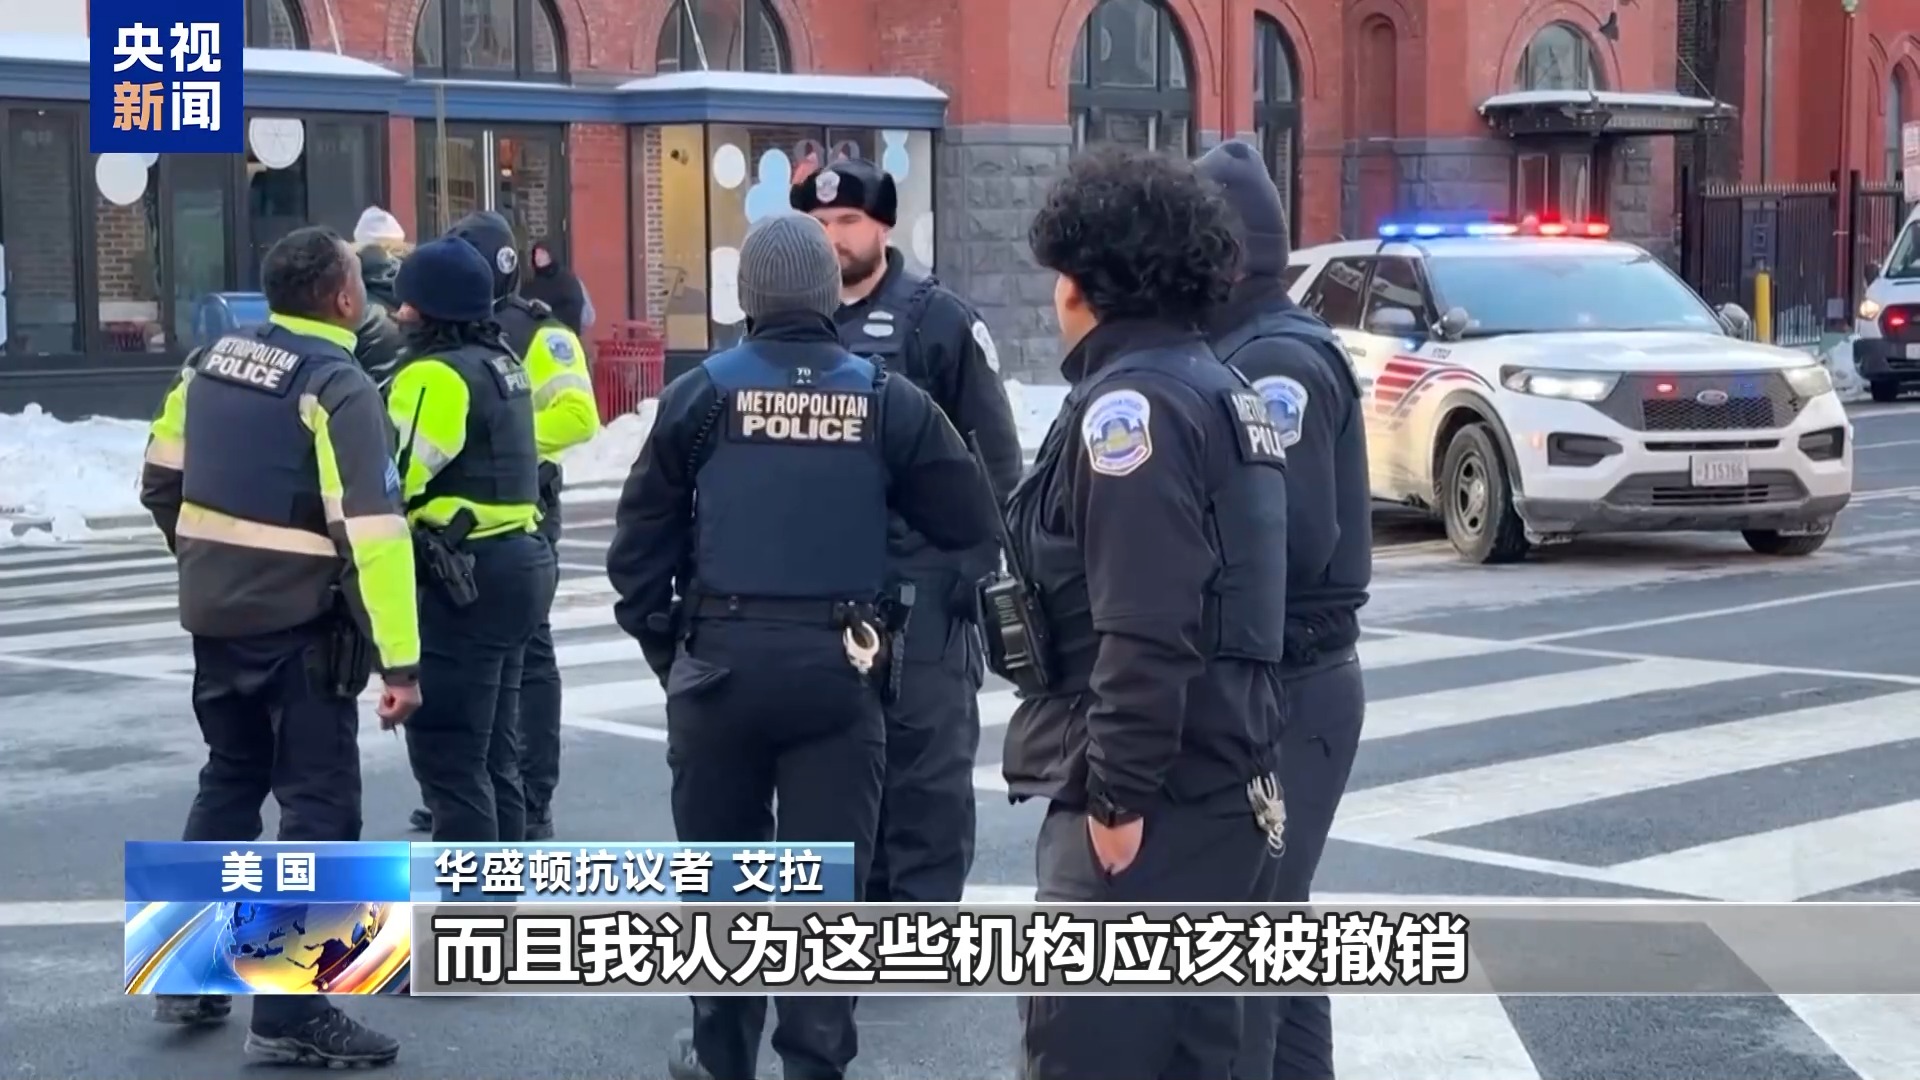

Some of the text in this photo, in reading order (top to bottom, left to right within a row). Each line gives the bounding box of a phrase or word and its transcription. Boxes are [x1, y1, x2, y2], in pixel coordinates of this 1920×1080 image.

[205, 354, 284, 389] POLICE
[737, 390, 868, 417] METROPOLITAN
[742, 415, 863, 441] POLICE
